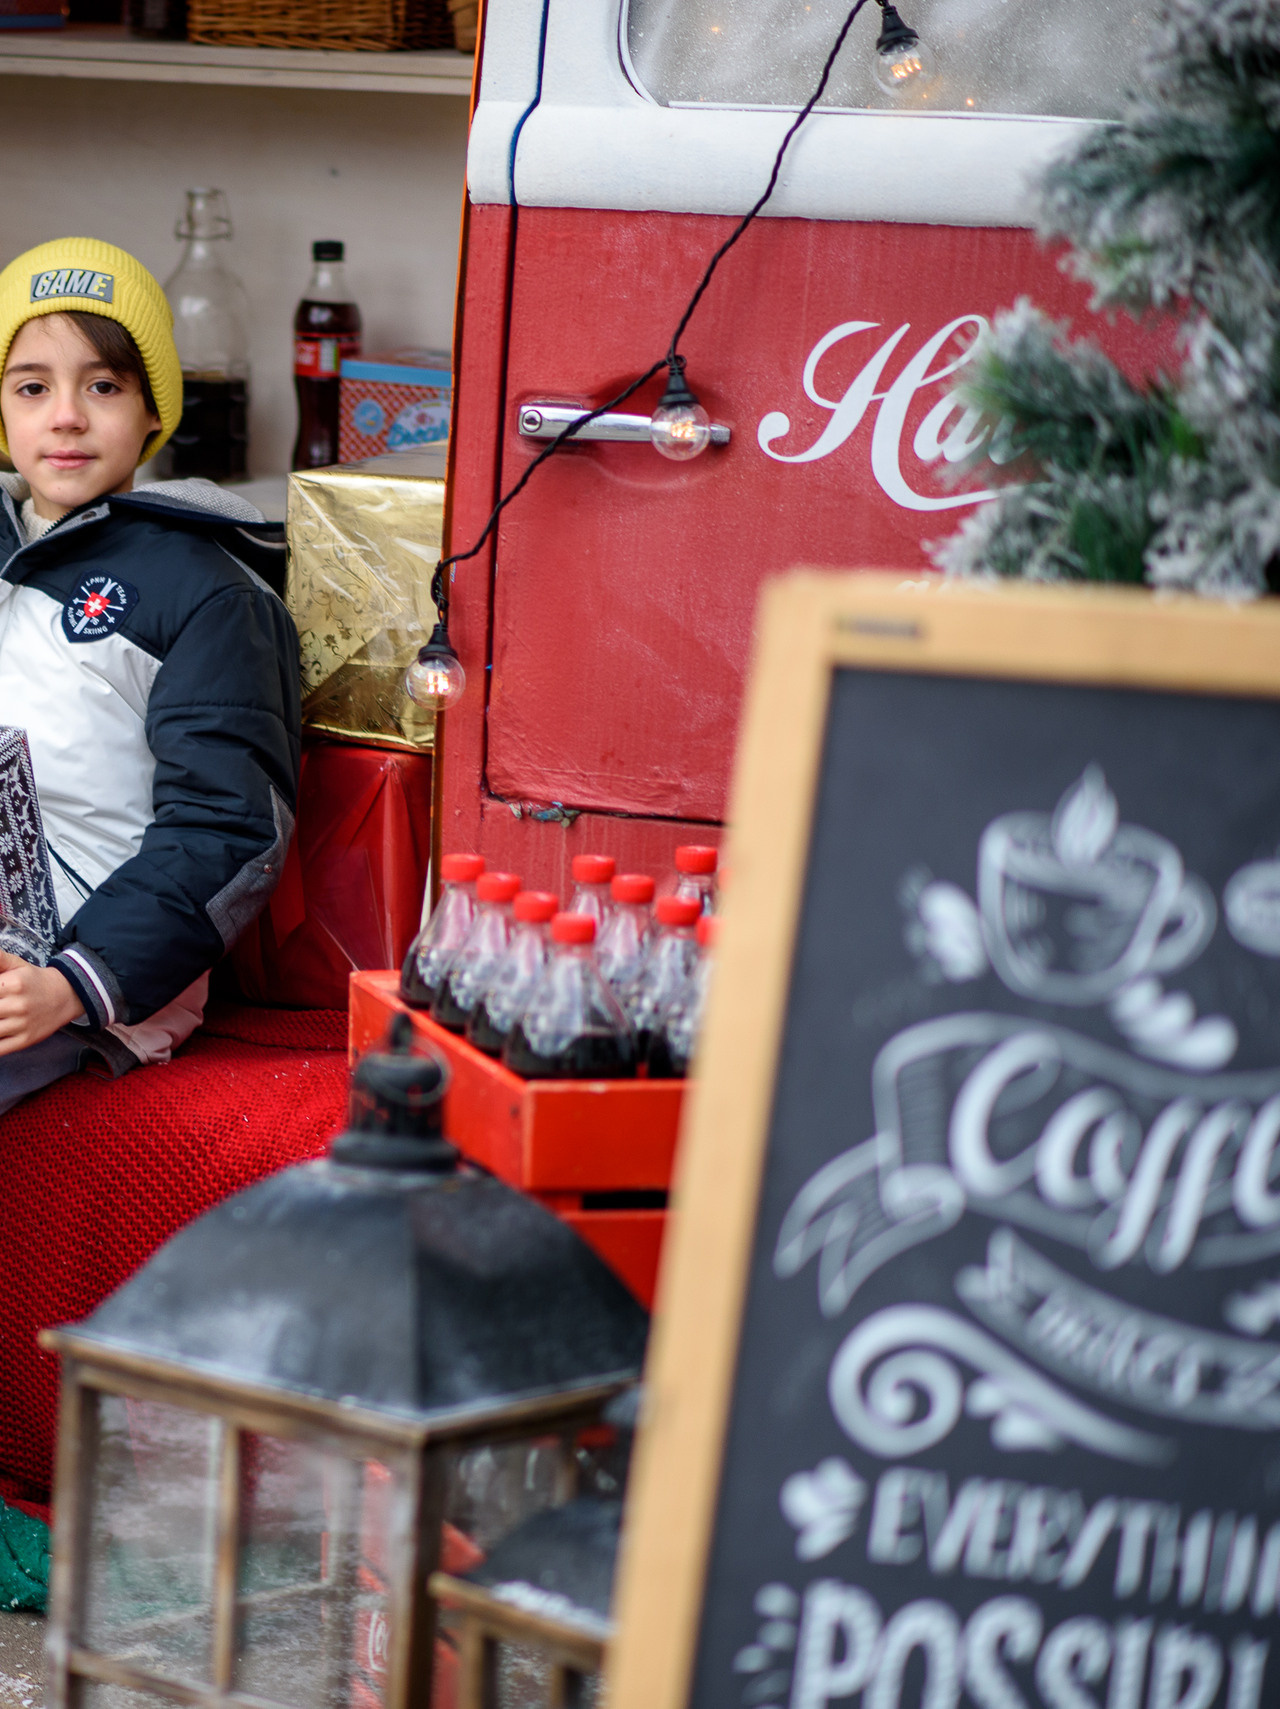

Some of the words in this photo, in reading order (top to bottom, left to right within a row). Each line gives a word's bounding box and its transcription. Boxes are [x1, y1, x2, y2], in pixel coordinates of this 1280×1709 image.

[33, 270, 112, 298] GAME
[115, 584, 127, 605] TEAM
[83, 625, 108, 635] SKIING
